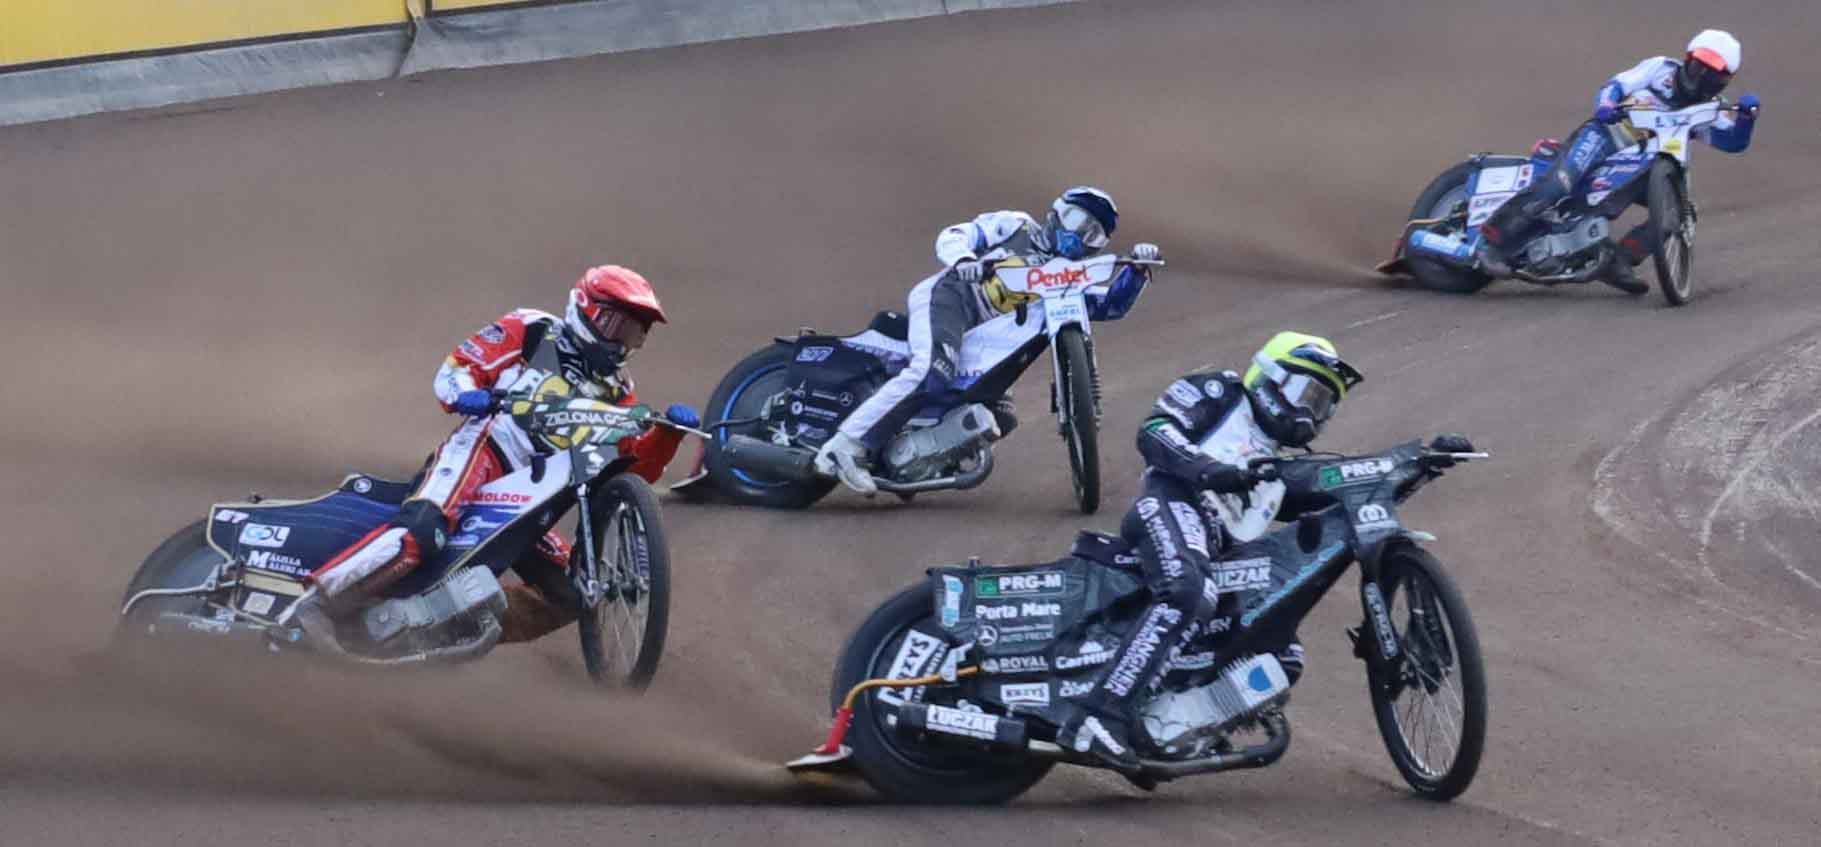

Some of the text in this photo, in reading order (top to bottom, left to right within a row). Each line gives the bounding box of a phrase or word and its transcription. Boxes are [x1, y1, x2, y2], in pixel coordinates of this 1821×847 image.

[1026, 263, 1090, 291] Pentel
[998, 573, 1062, 590] PRG-M
[1021, 603, 1062, 617] Mare
[1000, 656, 1048, 669] ROYAL
